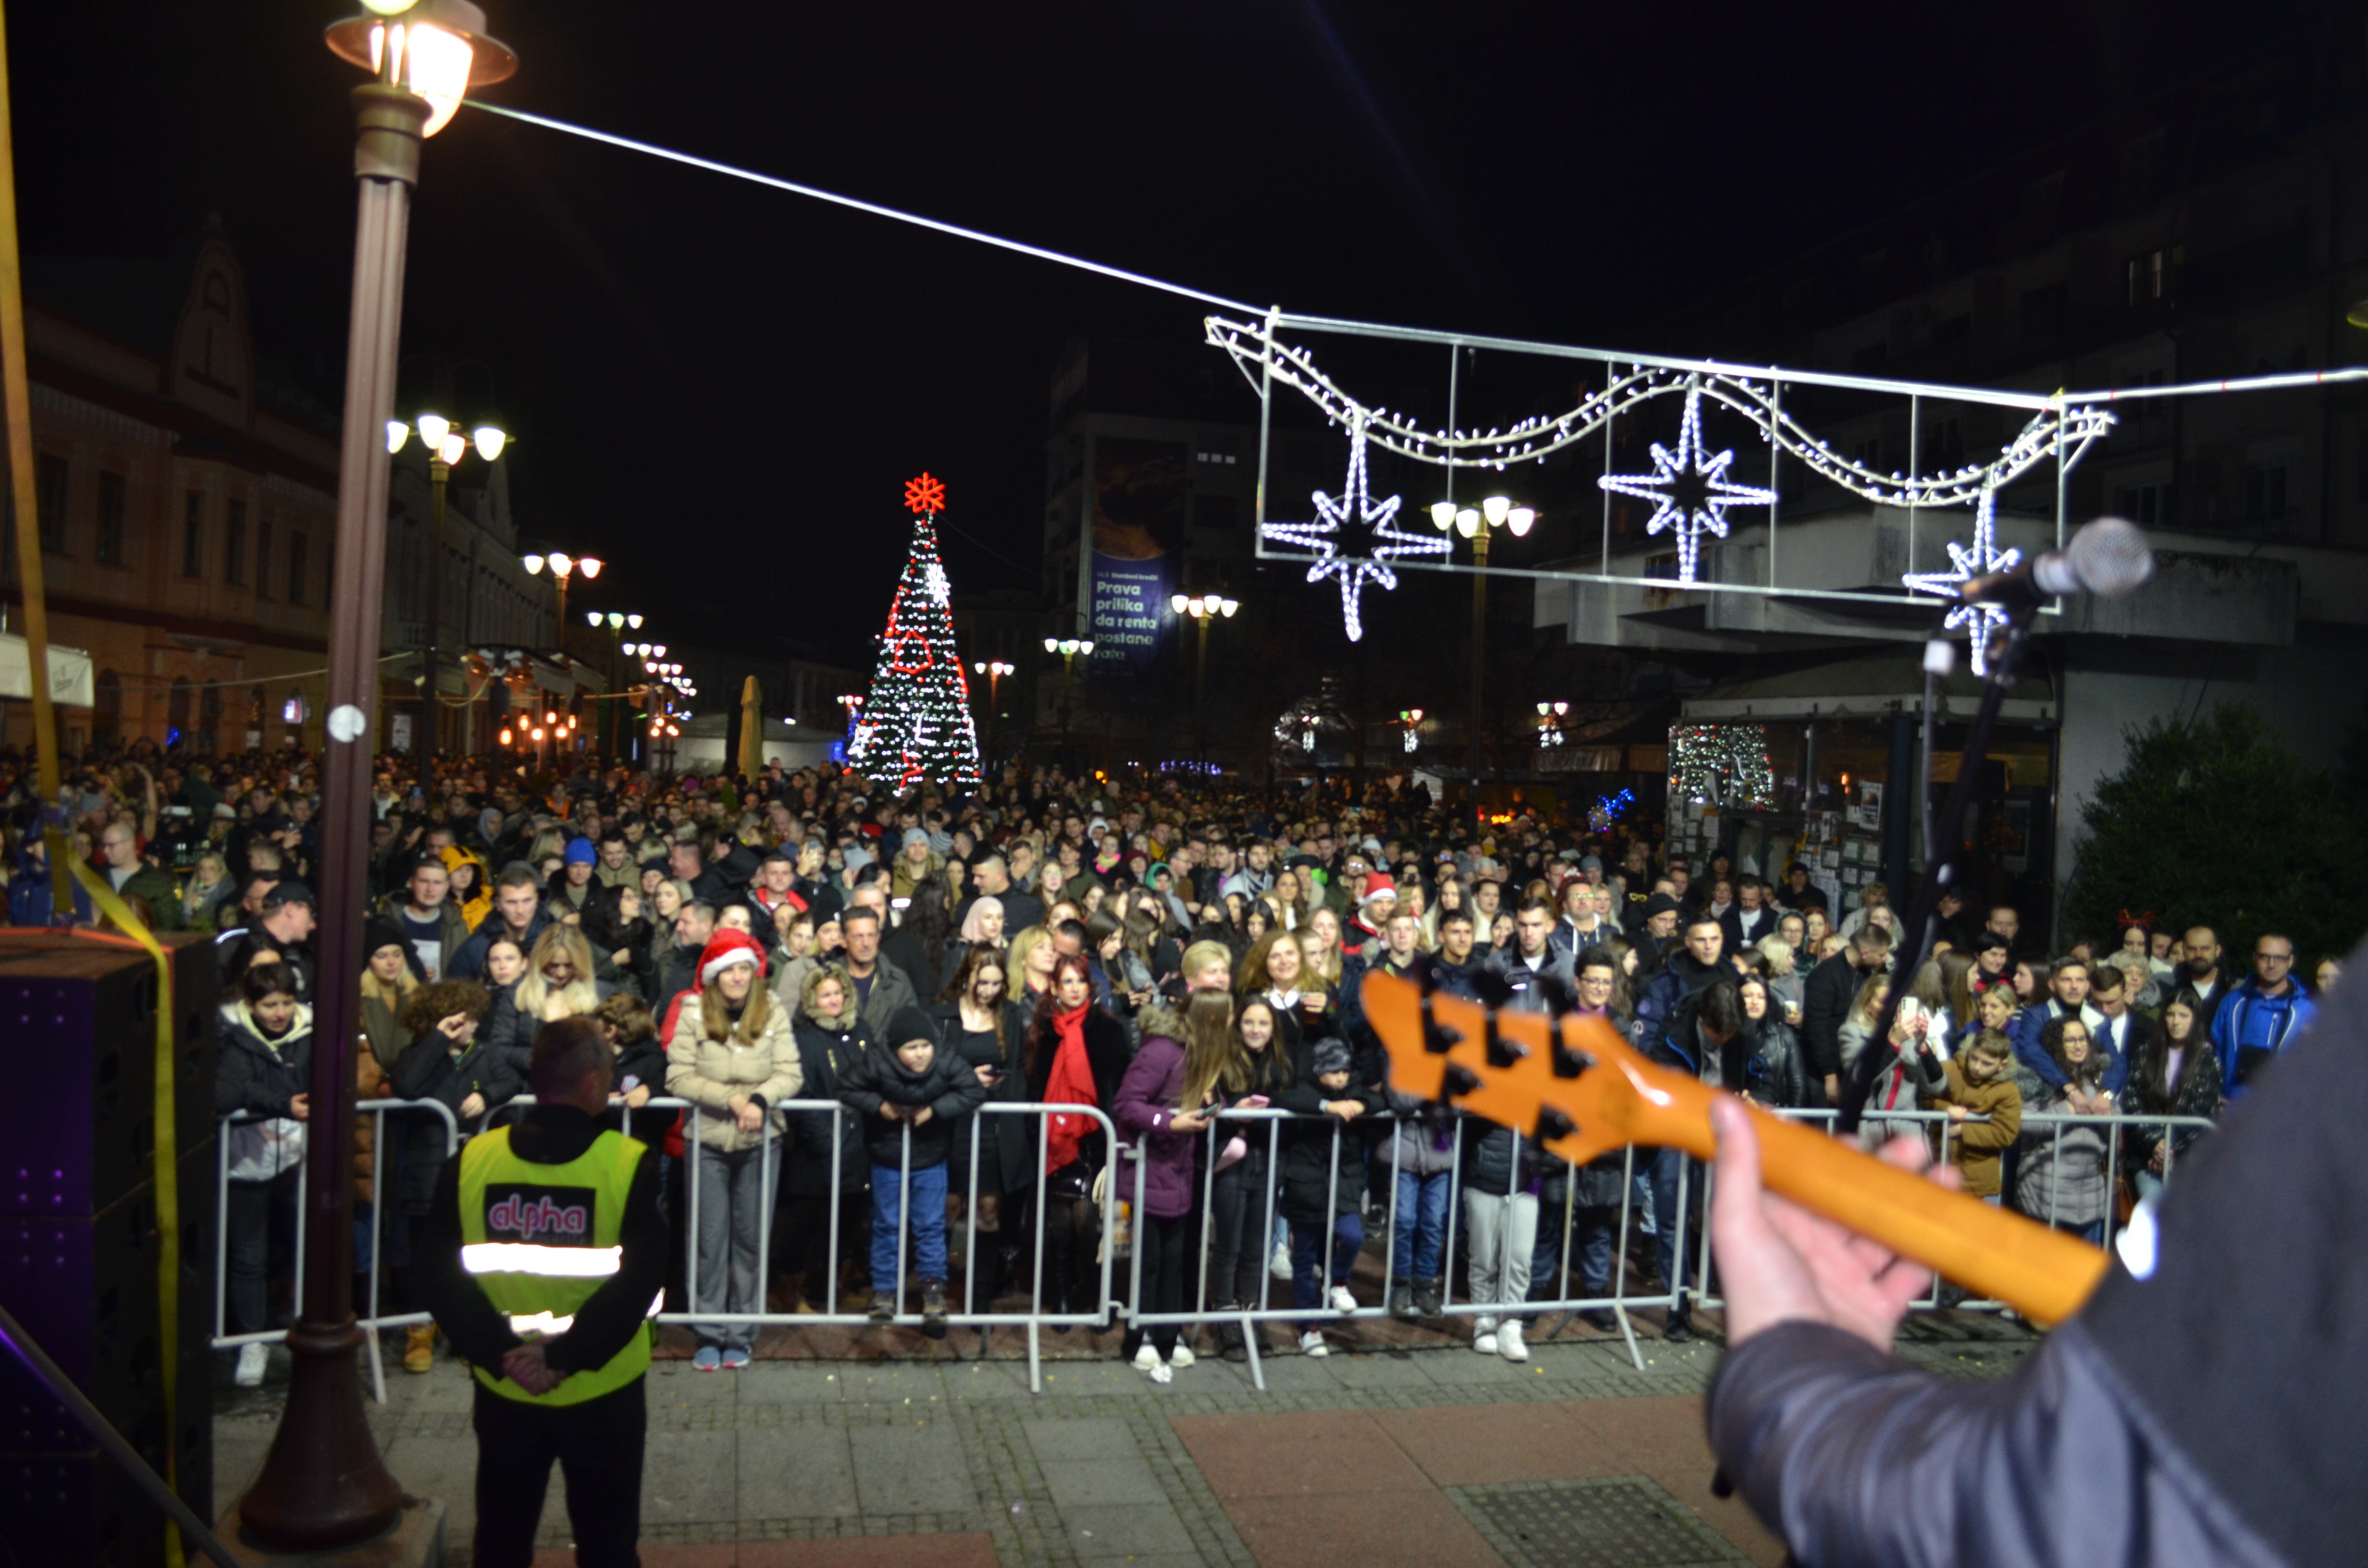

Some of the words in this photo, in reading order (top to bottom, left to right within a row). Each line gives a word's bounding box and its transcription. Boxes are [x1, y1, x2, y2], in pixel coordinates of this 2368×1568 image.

[1097, 581, 1141, 595] Prava
[1096, 598, 1144, 612] prilika
[1095, 613, 1115, 626] da
[1118, 617, 1157, 629] renta
[1095, 632, 1153, 645] postane
[1094, 649, 1124, 660] rata
[490, 1193, 587, 1239] alpha
